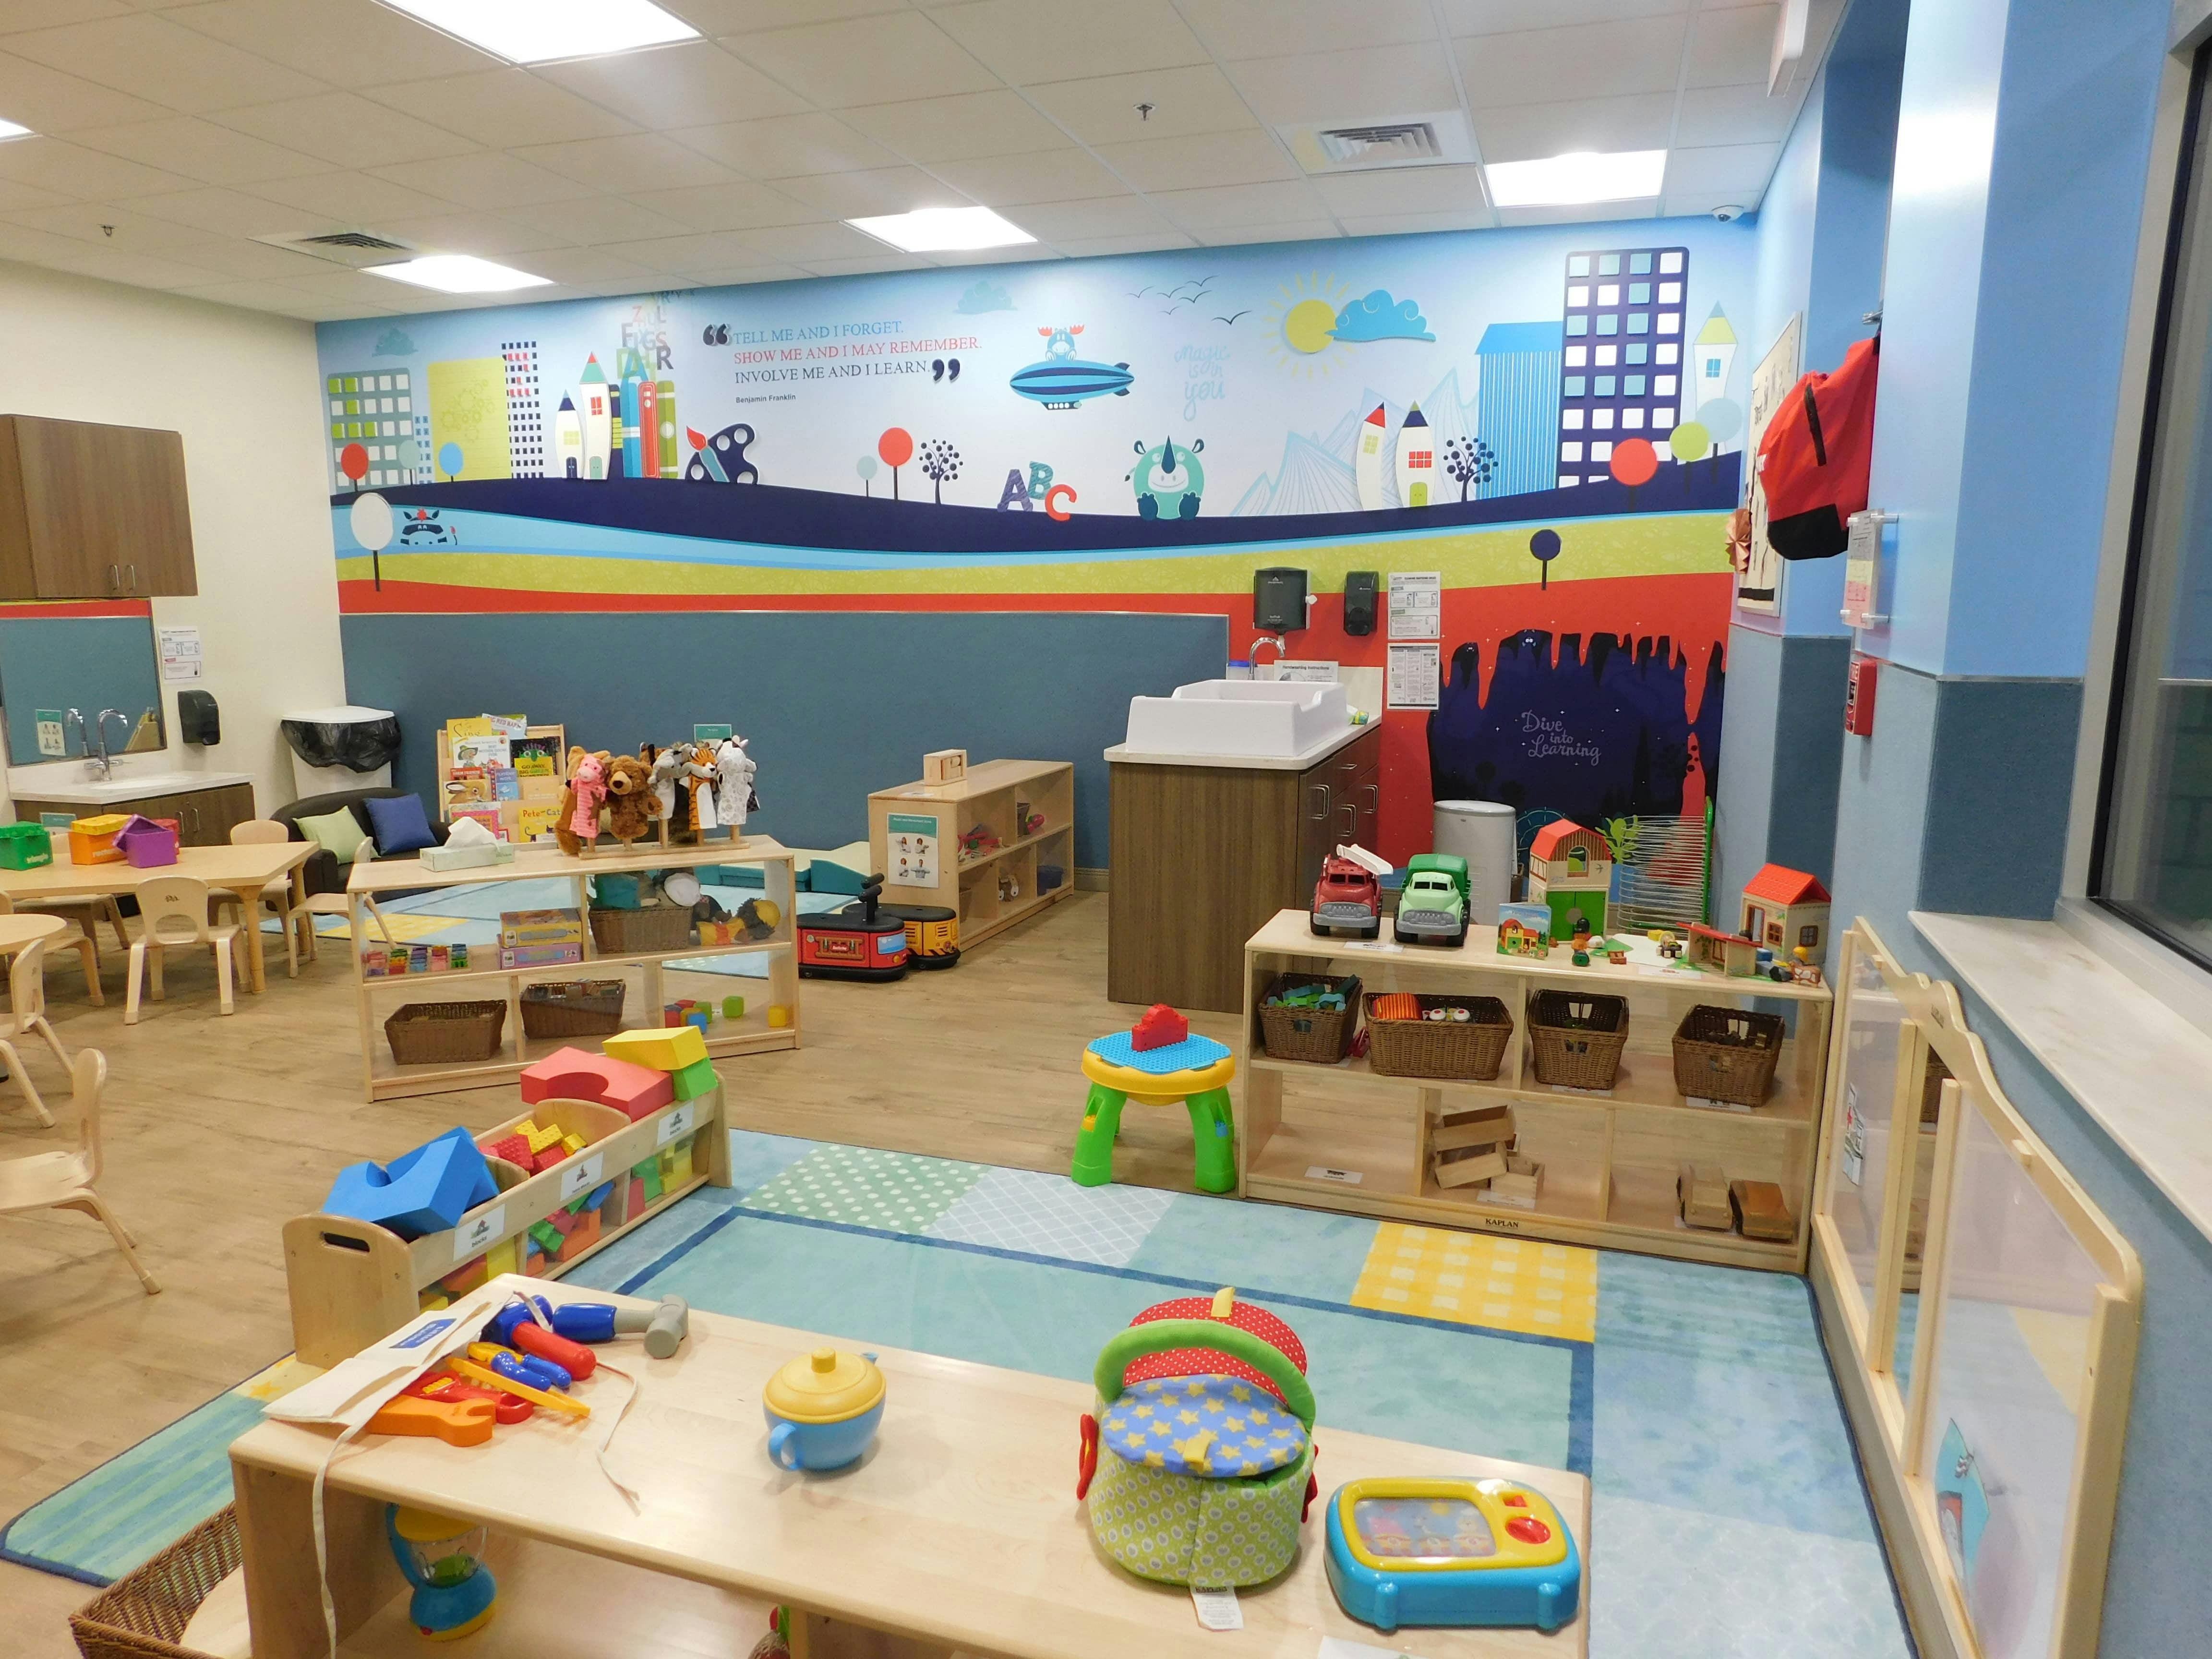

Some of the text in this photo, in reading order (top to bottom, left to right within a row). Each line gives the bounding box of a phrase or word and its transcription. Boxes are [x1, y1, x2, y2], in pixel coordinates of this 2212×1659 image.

[733, 321, 904, 344] TELL ME AND I FORGET.
[734, 337, 982, 364] SHOW ME AND I MAY REMEMBER.
[735, 361, 930, 384] INVOLVE ME AND I LEARN.
[769, 394, 796, 402] Franklin
[1184, 381, 1226, 421] you
[997, 461, 1077, 522] ABC
[1521, 709, 1563, 732] Dive
[1550, 730, 1574, 744] into
[1528, 734, 1601, 766] Learning
[1486, 1218, 1518, 1227] KAPLAN
[471, 1236, 487, 1247] blocks
